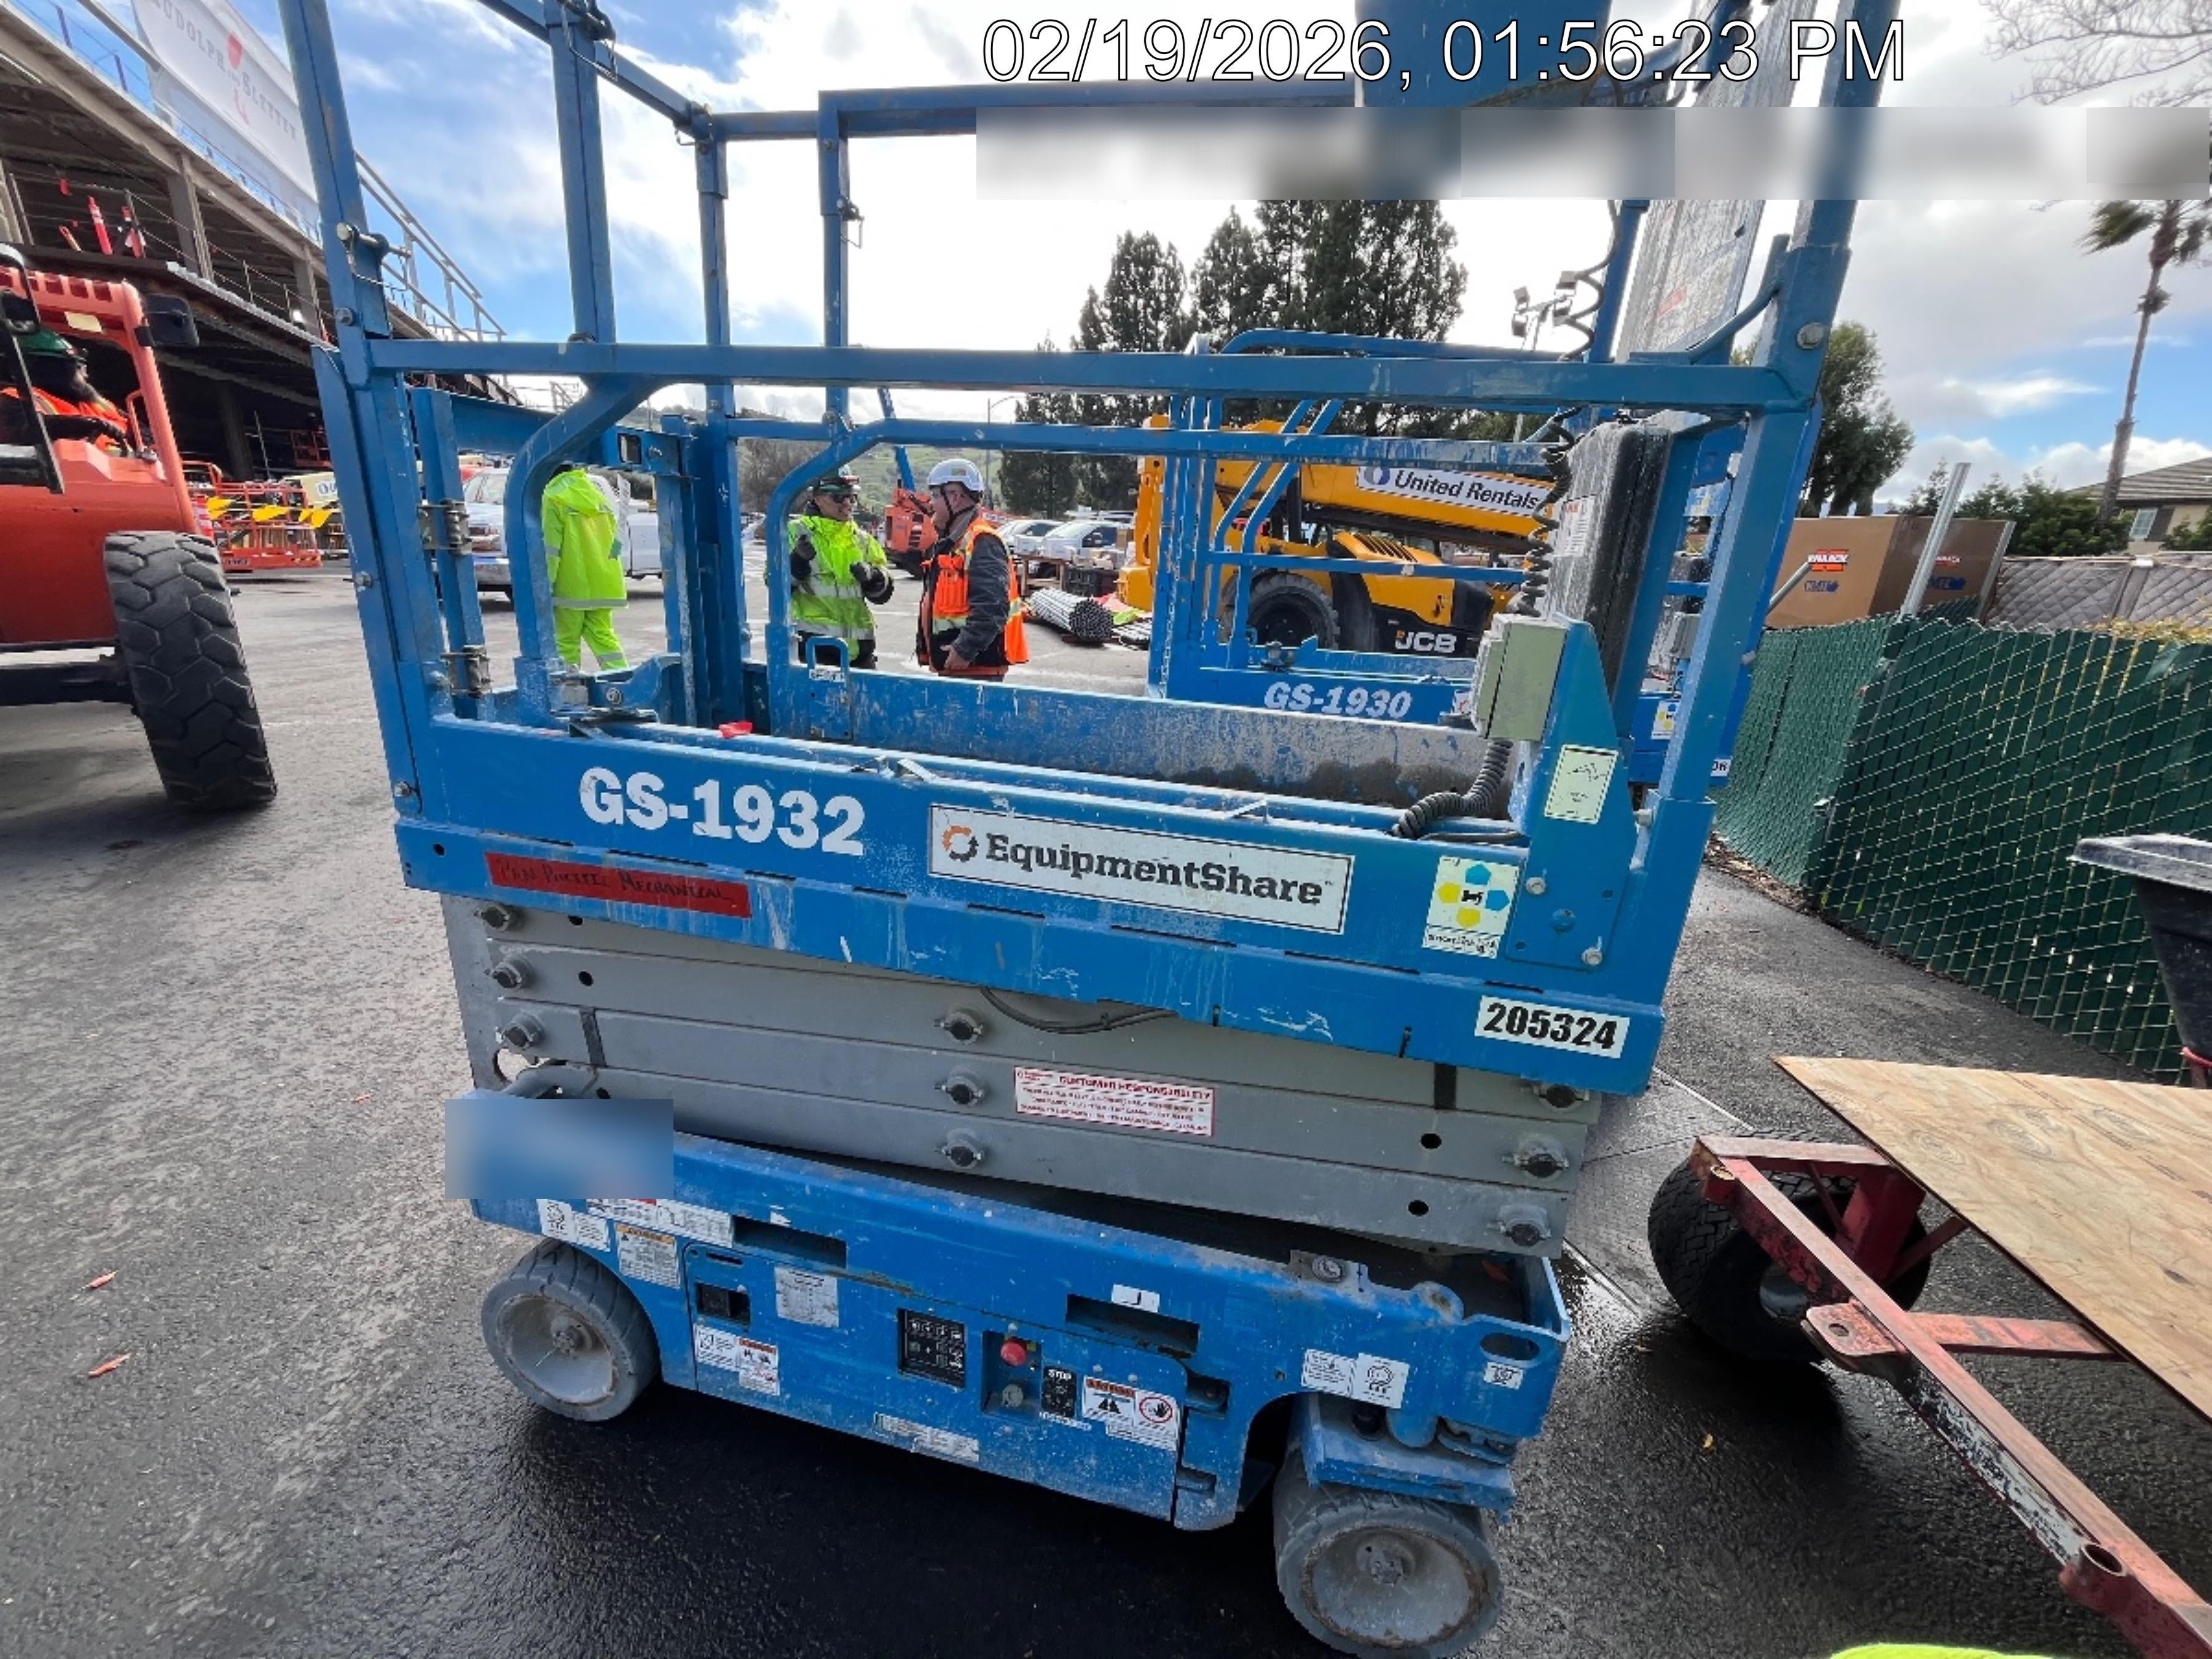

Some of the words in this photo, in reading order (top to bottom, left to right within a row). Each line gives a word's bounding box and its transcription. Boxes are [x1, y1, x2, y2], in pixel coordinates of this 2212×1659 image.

[1394, 470, 1464, 498] United
[1465, 482, 1539, 509] Rentals
[1395, 630, 1457, 653] JCB
[1265, 682, 1412, 718] GS-1930
[580, 767, 865, 855] GS-1932
[986, 833, 1322, 906] EquipmentShare
[1483, 1003, 1617, 1049] 205324
